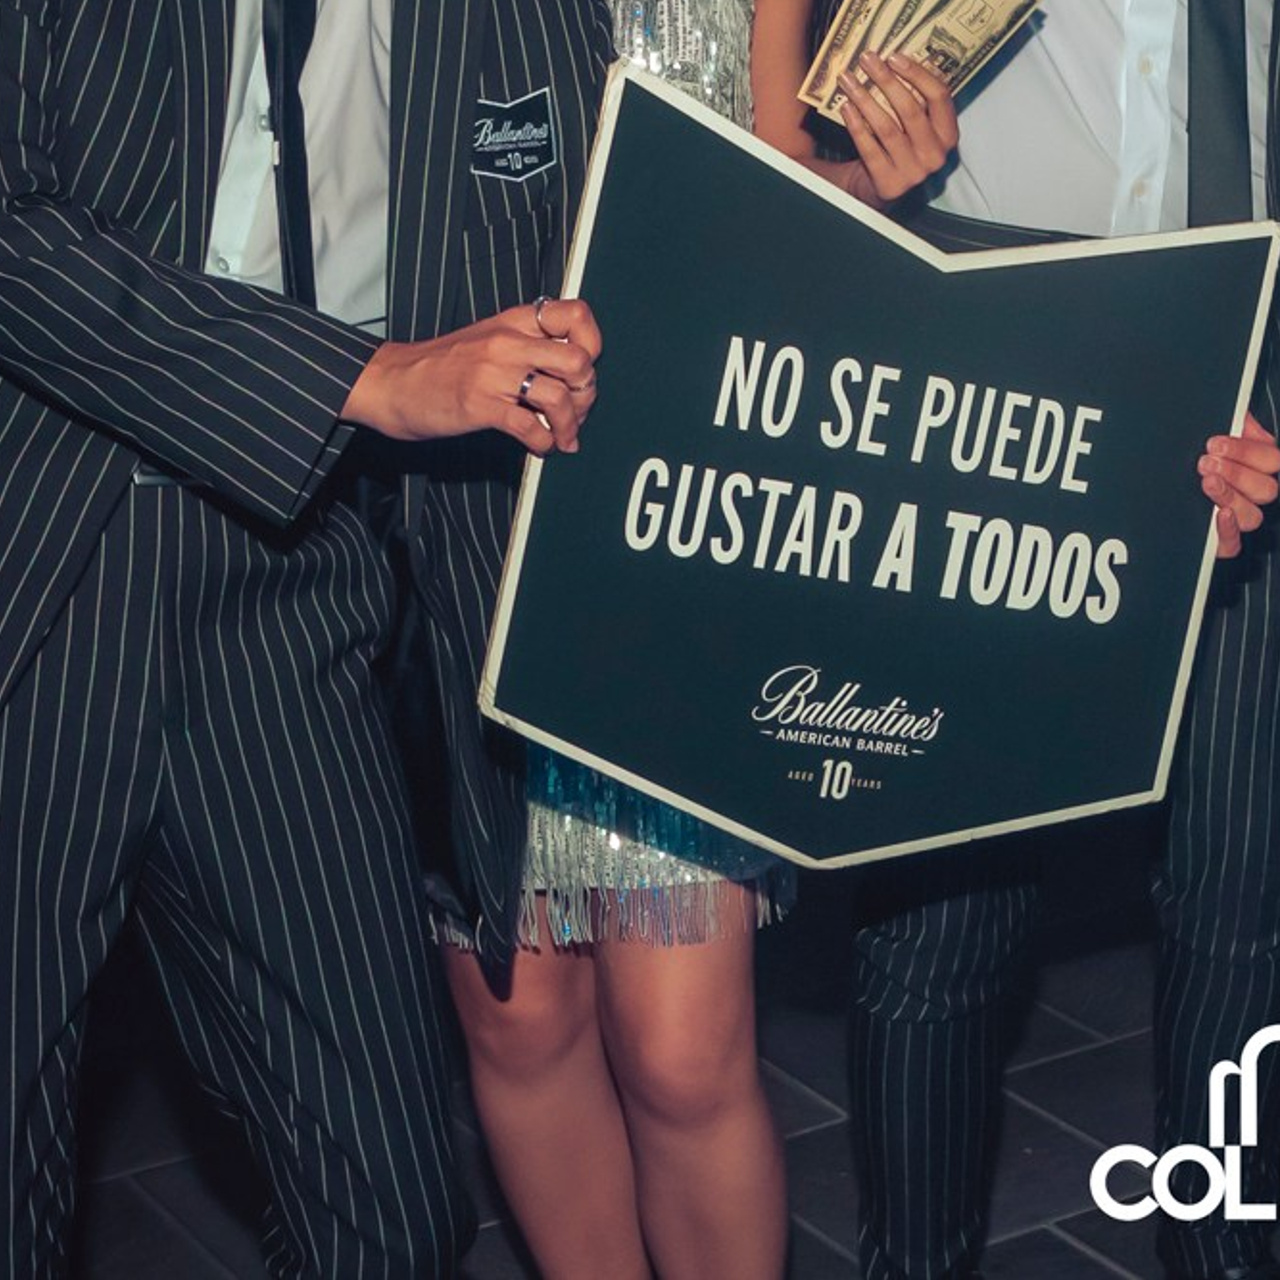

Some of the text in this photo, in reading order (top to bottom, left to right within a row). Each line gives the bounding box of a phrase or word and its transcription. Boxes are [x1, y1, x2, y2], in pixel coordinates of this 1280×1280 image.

[507, 152, 522, 171] 10
[713, 336, 1103, 494] NO SE PUEDE
[624, 457, 1128, 624] GUSTAR A TODOS
[751, 664, 945, 742] Ballantine's
[775, 728, 909, 757] AMERICAN BARREL
[787, 758, 882, 800] AGED 10 YEARS
